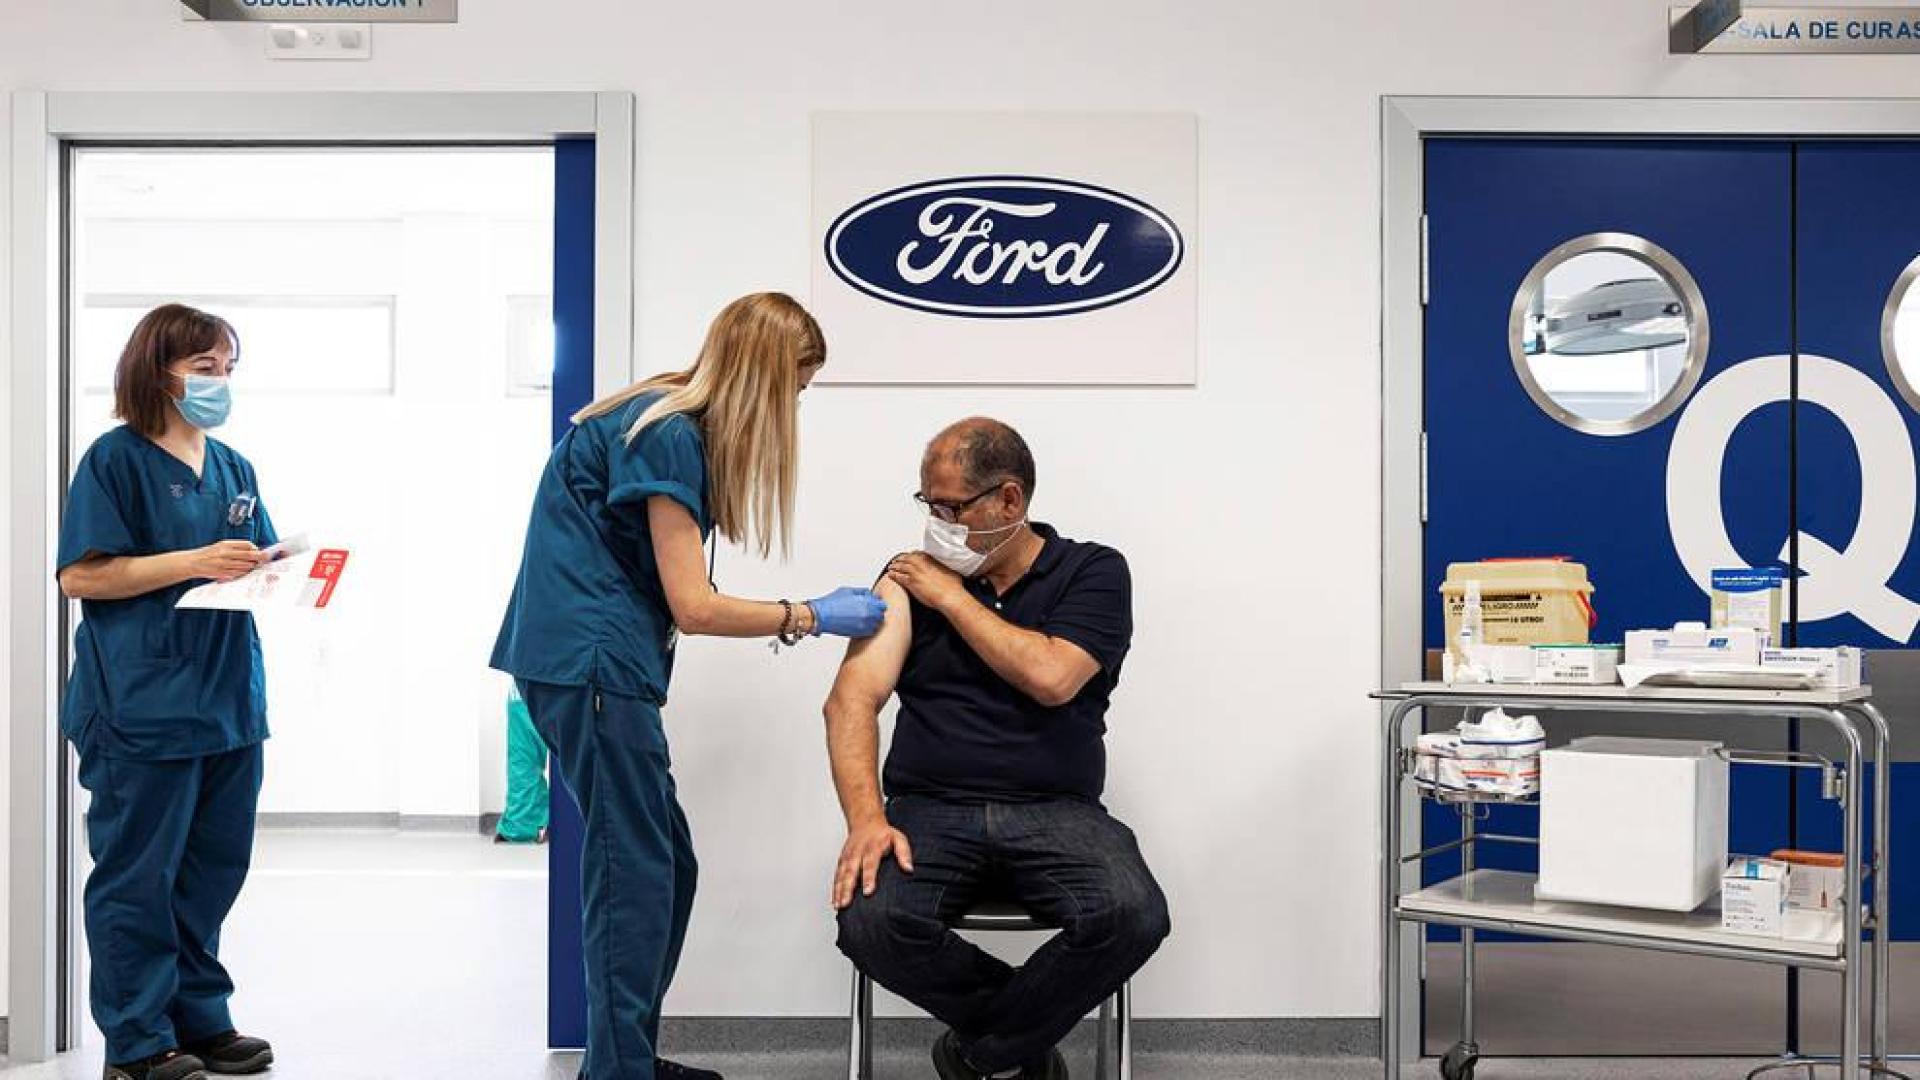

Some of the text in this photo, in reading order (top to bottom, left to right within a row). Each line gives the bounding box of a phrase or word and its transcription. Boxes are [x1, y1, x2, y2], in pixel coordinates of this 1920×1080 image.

[1739, 21, 1800, 39] SALA
[1808, 21, 1839, 39] DE
[896, 197, 1110, 286] Ford
[1666, 354, 1920, 644] Q
